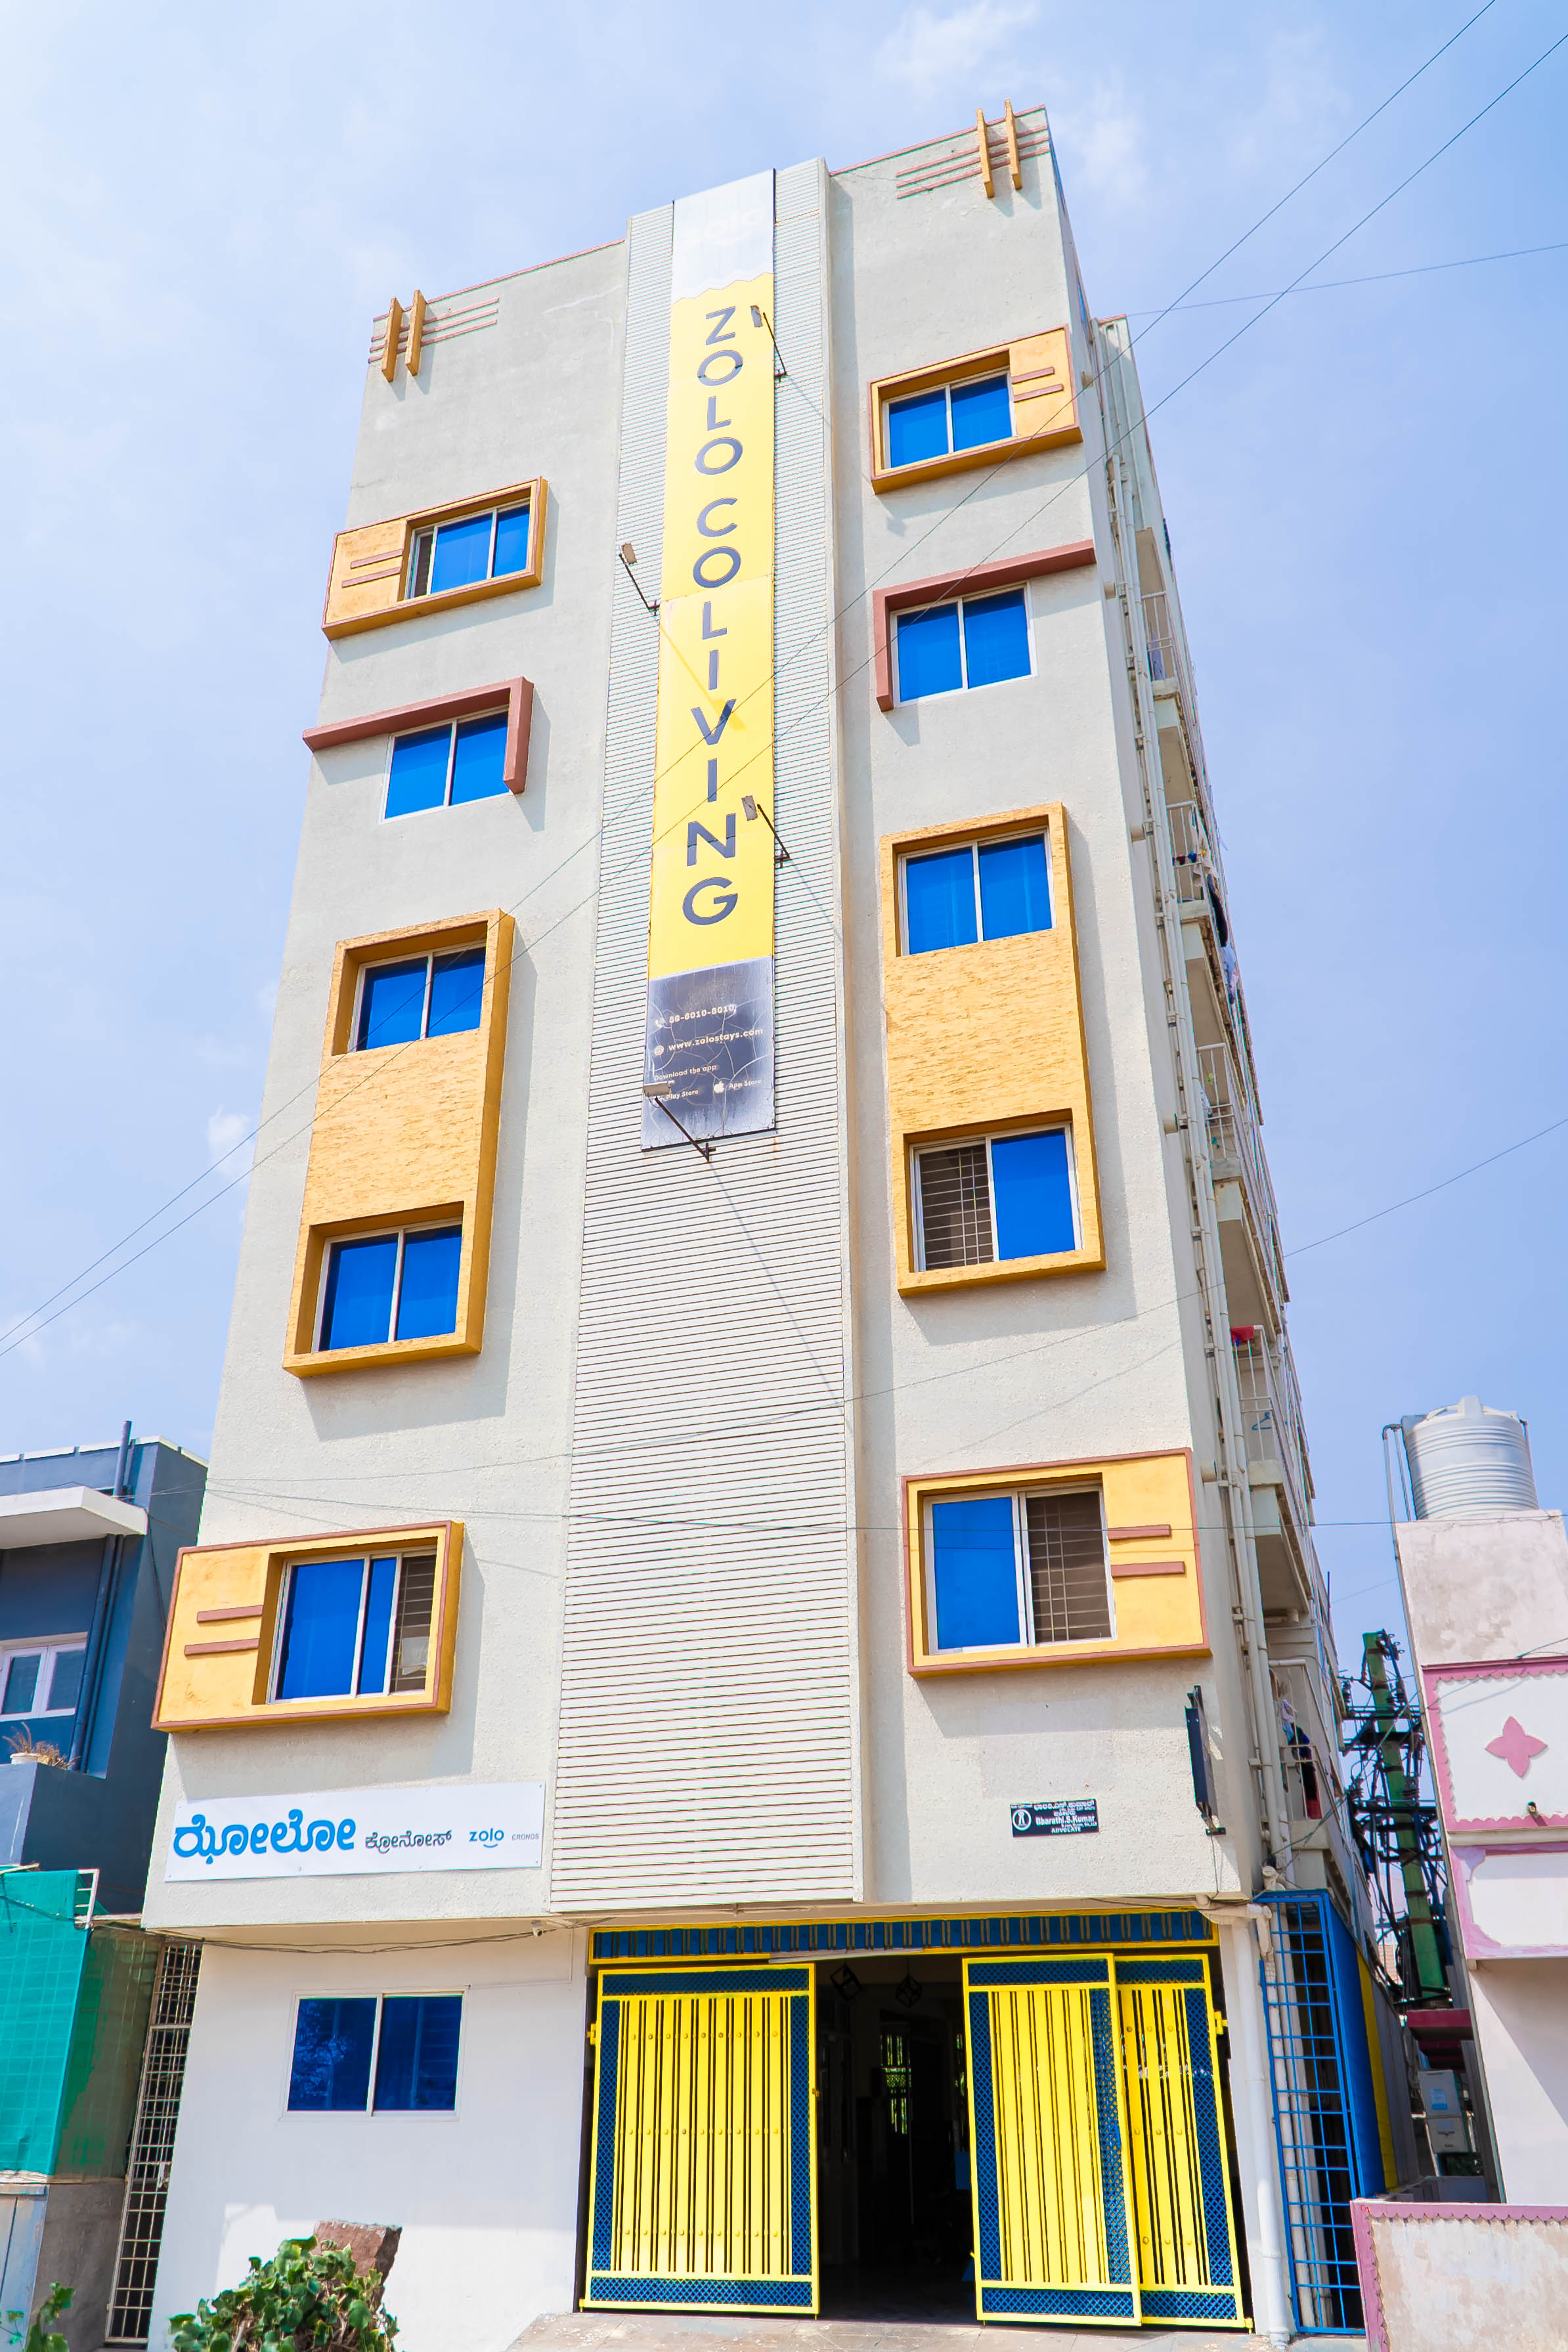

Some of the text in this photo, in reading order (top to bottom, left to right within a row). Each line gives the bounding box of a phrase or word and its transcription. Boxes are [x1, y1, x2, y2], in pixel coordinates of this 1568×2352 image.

[696, 305, 743, 475] ZOLO
[668, 1030, 763, 1051] www.zolostays.com
[655, 1070, 687, 1080] Download
[469, 1828, 505, 1842] zolo
